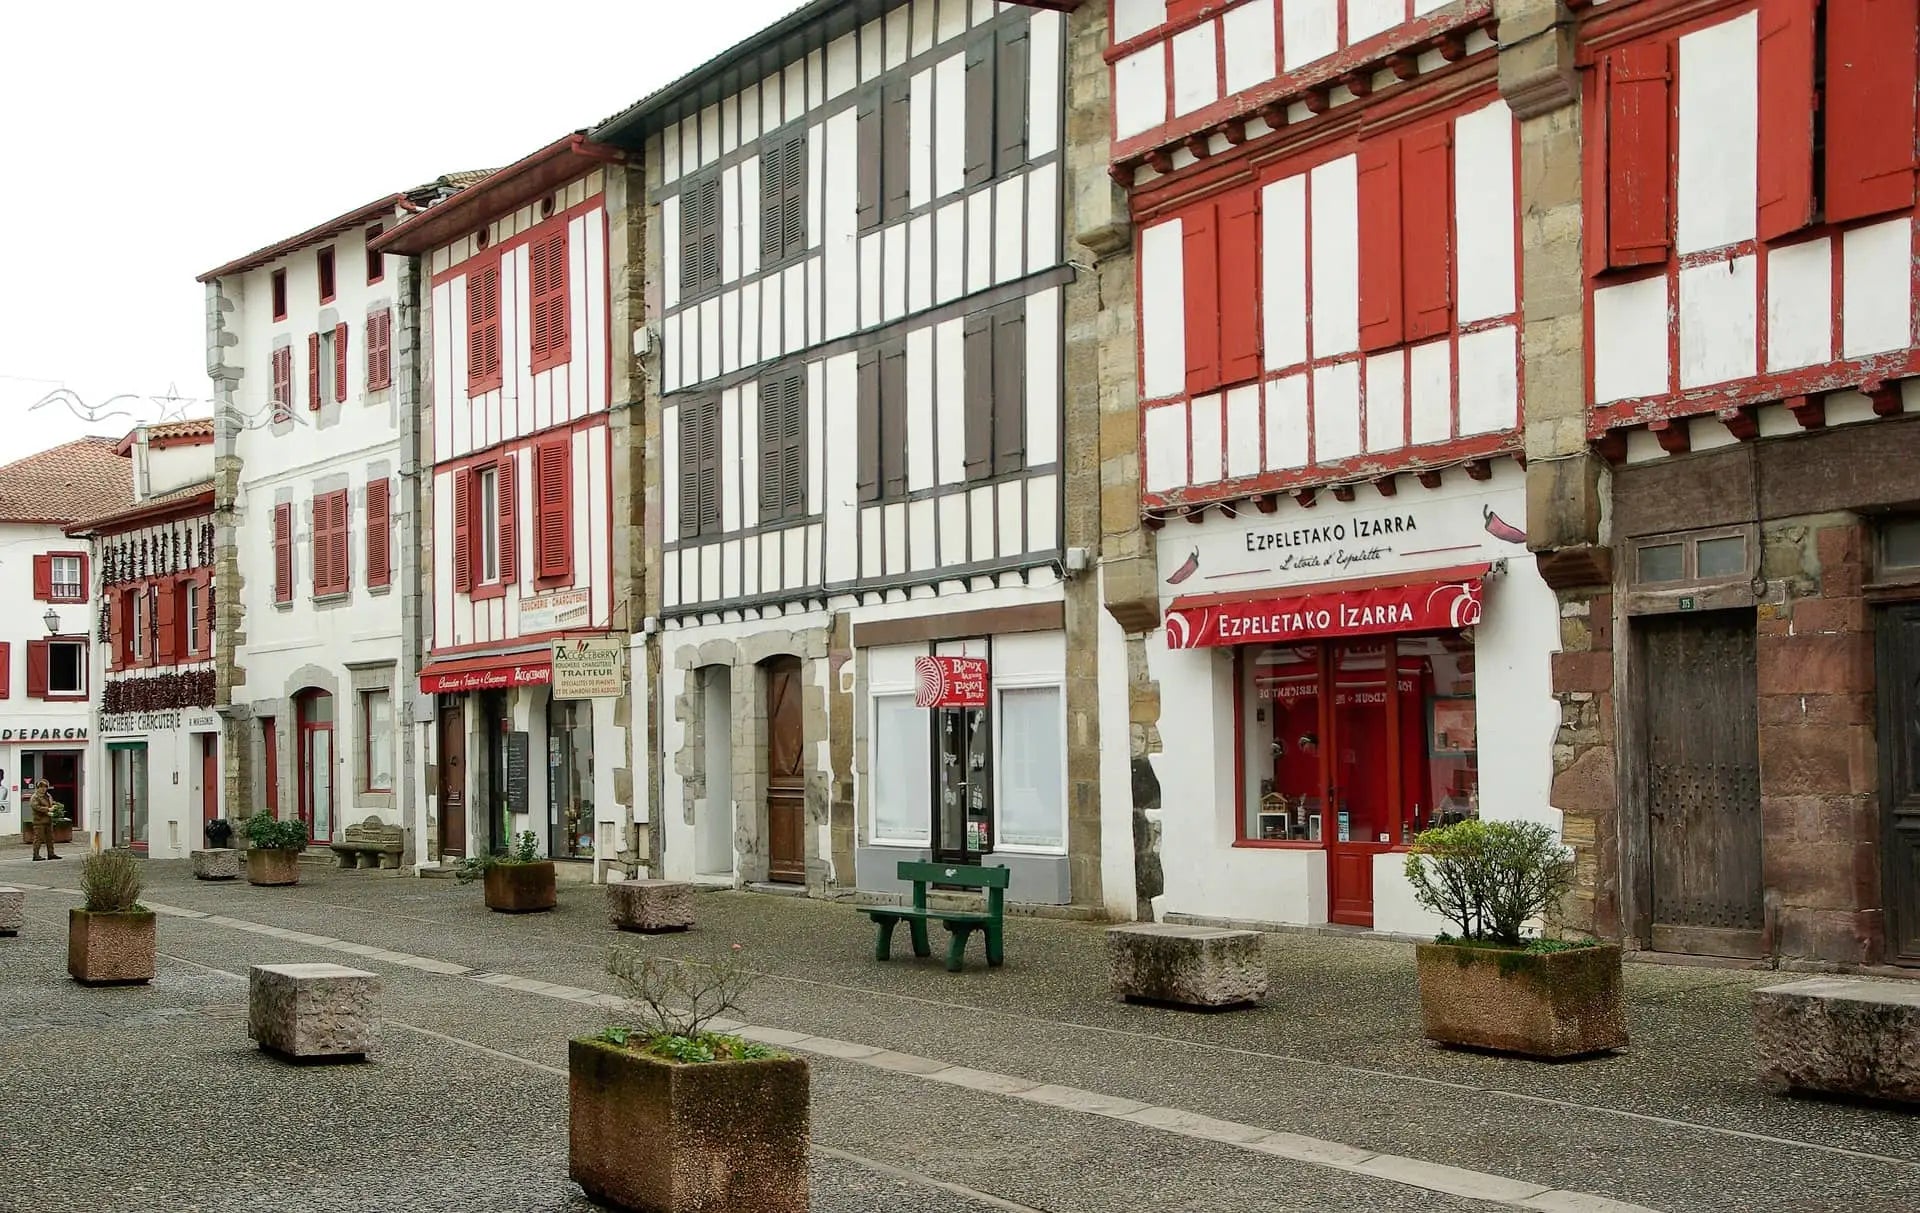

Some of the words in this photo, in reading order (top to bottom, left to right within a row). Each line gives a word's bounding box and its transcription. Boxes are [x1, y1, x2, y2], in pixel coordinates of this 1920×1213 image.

[1246, 524, 1345, 551] EZPELETAKO
[1353, 515, 1417, 538] IZARRA
[1219, 609, 1331, 637] EZPELETAKO
[1340, 602, 1414, 628] IZARRA
[561, 669, 613, 678] TRAITEUR
[100, 715, 135, 733] BOUCHERIE
[138, 711, 181, 733] CHARCUTERIE
